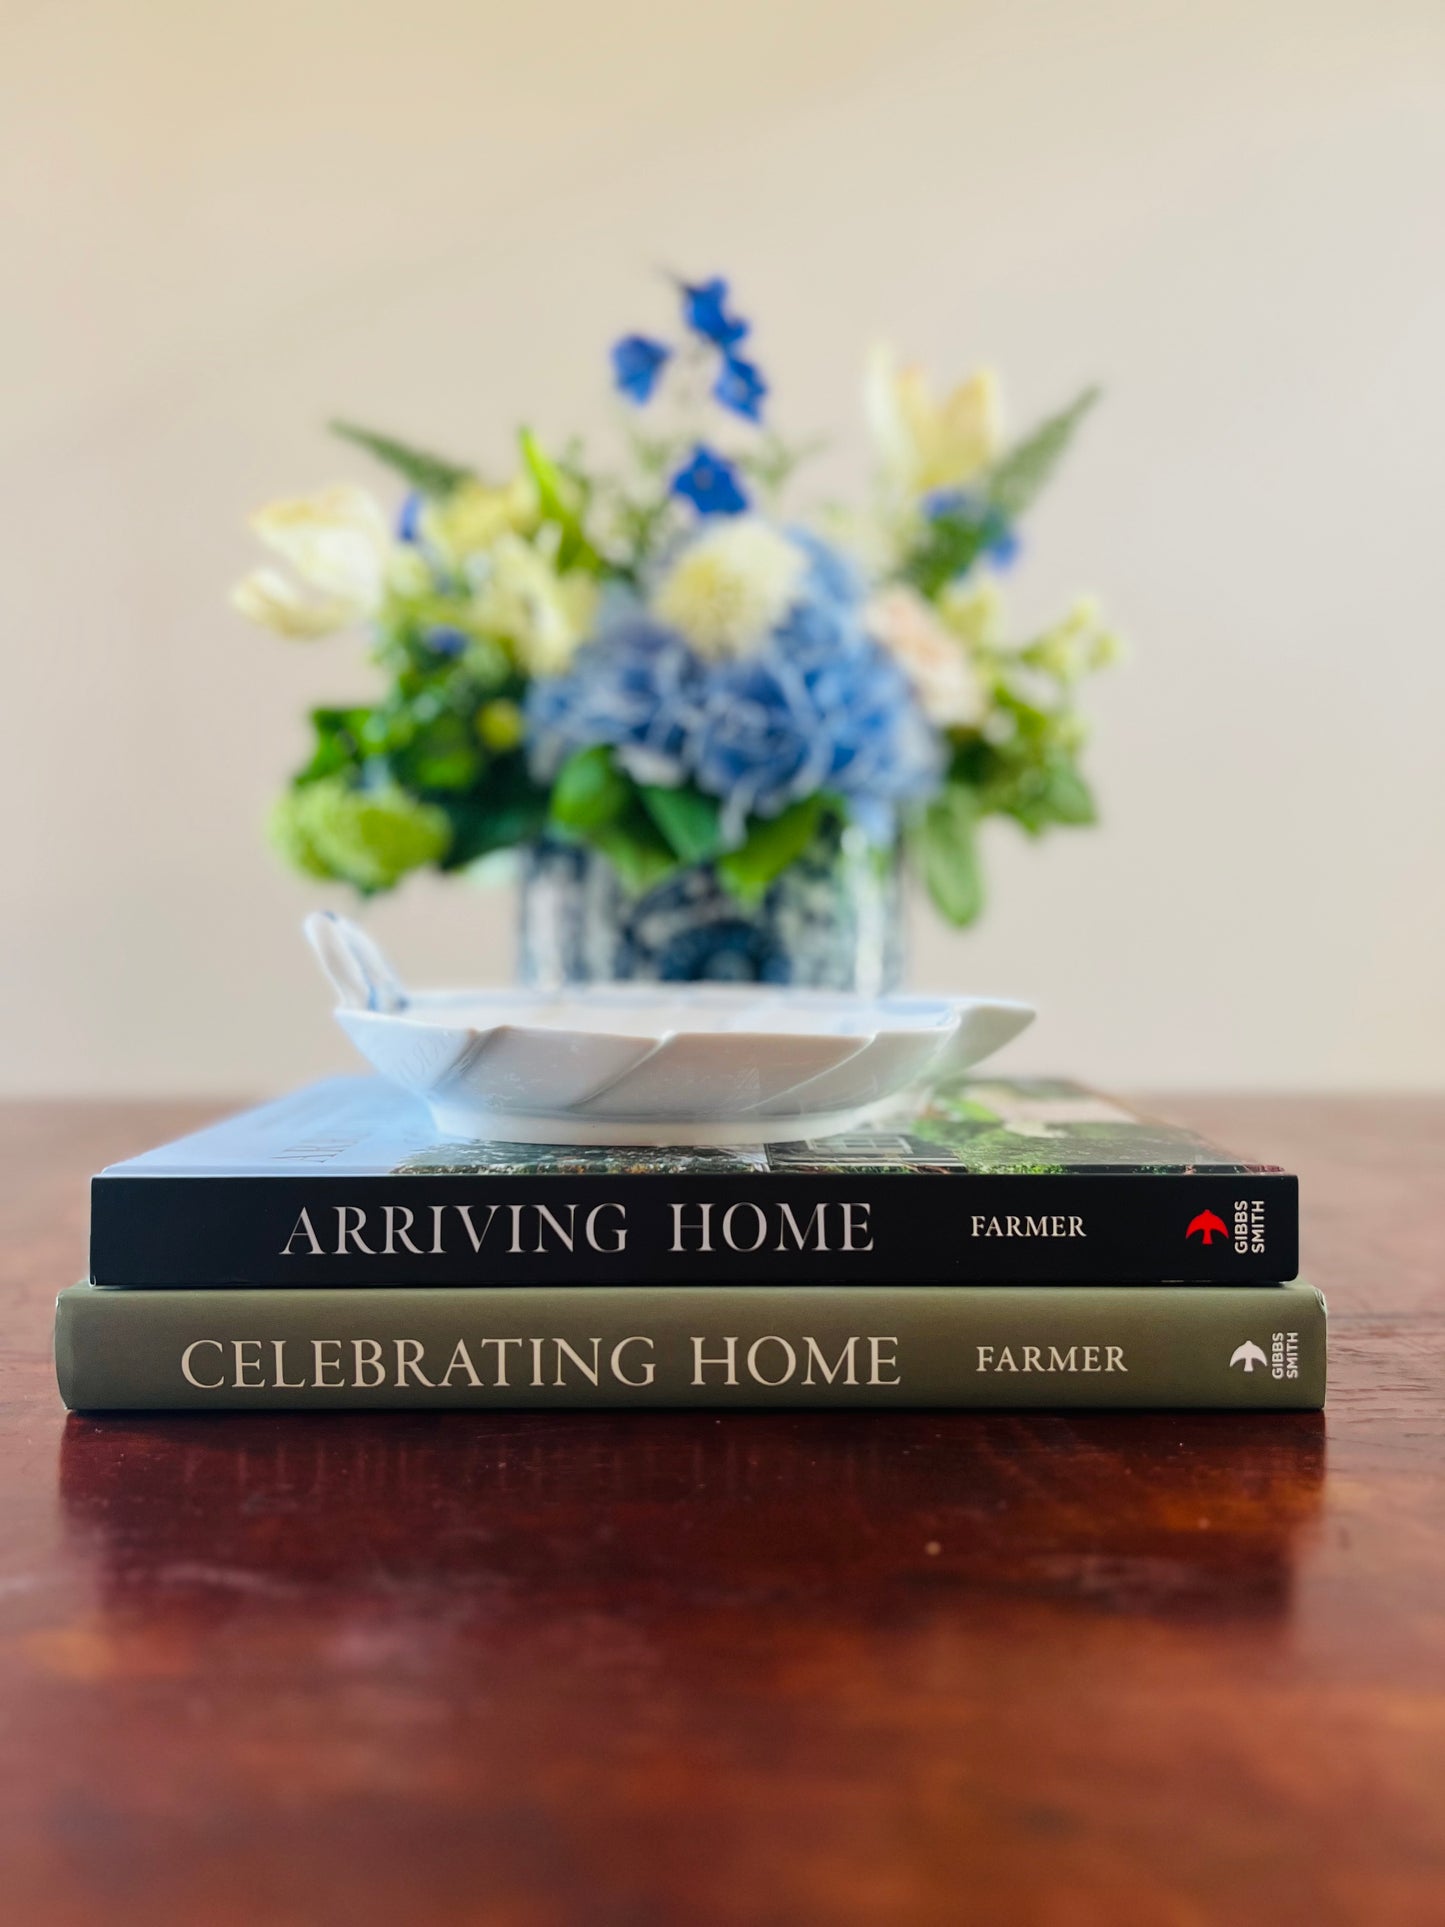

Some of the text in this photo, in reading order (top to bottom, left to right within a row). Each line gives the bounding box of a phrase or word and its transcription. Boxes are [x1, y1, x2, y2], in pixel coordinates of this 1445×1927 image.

[279, 1202, 875, 1255] ARRIVING HOME
[970, 1214, 1088, 1238] FARMER
[1234, 1200, 1249, 1254] GIBBS
[1251, 1200, 1265, 1254] SMITH
[181, 1334, 902, 1390] CELEBRATING HOME
[975, 1345, 1128, 1373] FARMER
[1272, 1332, 1285, 1379] GIBBS
[1286, 1332, 1299, 1379] SMITH
